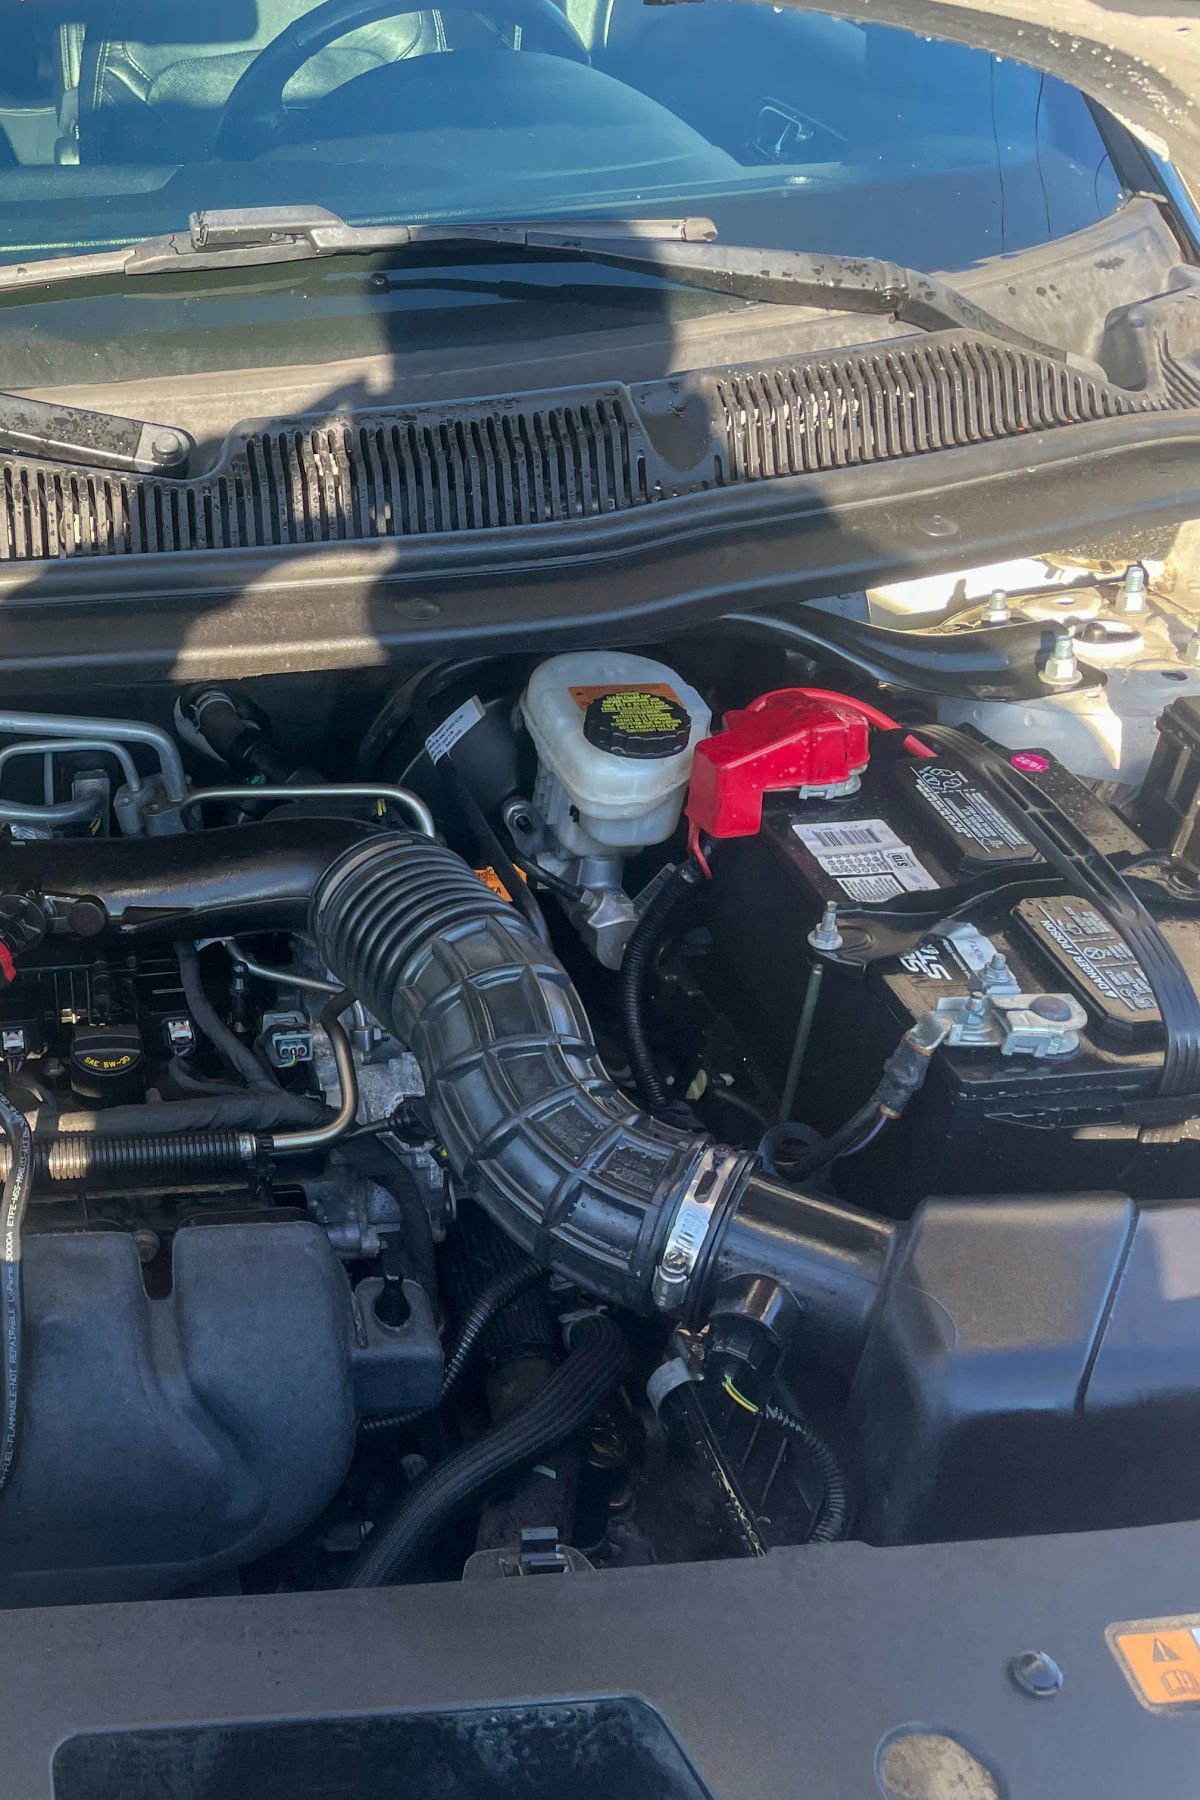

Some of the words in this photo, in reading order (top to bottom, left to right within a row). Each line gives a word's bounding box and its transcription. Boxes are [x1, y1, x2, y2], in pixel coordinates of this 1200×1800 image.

[1040, 919, 1073, 950] POISON
[1072, 955, 1110, 990] DANGER
[84, 1056, 100, 1067] SAE
[103, 1055, 131, 1069] 5W-30
